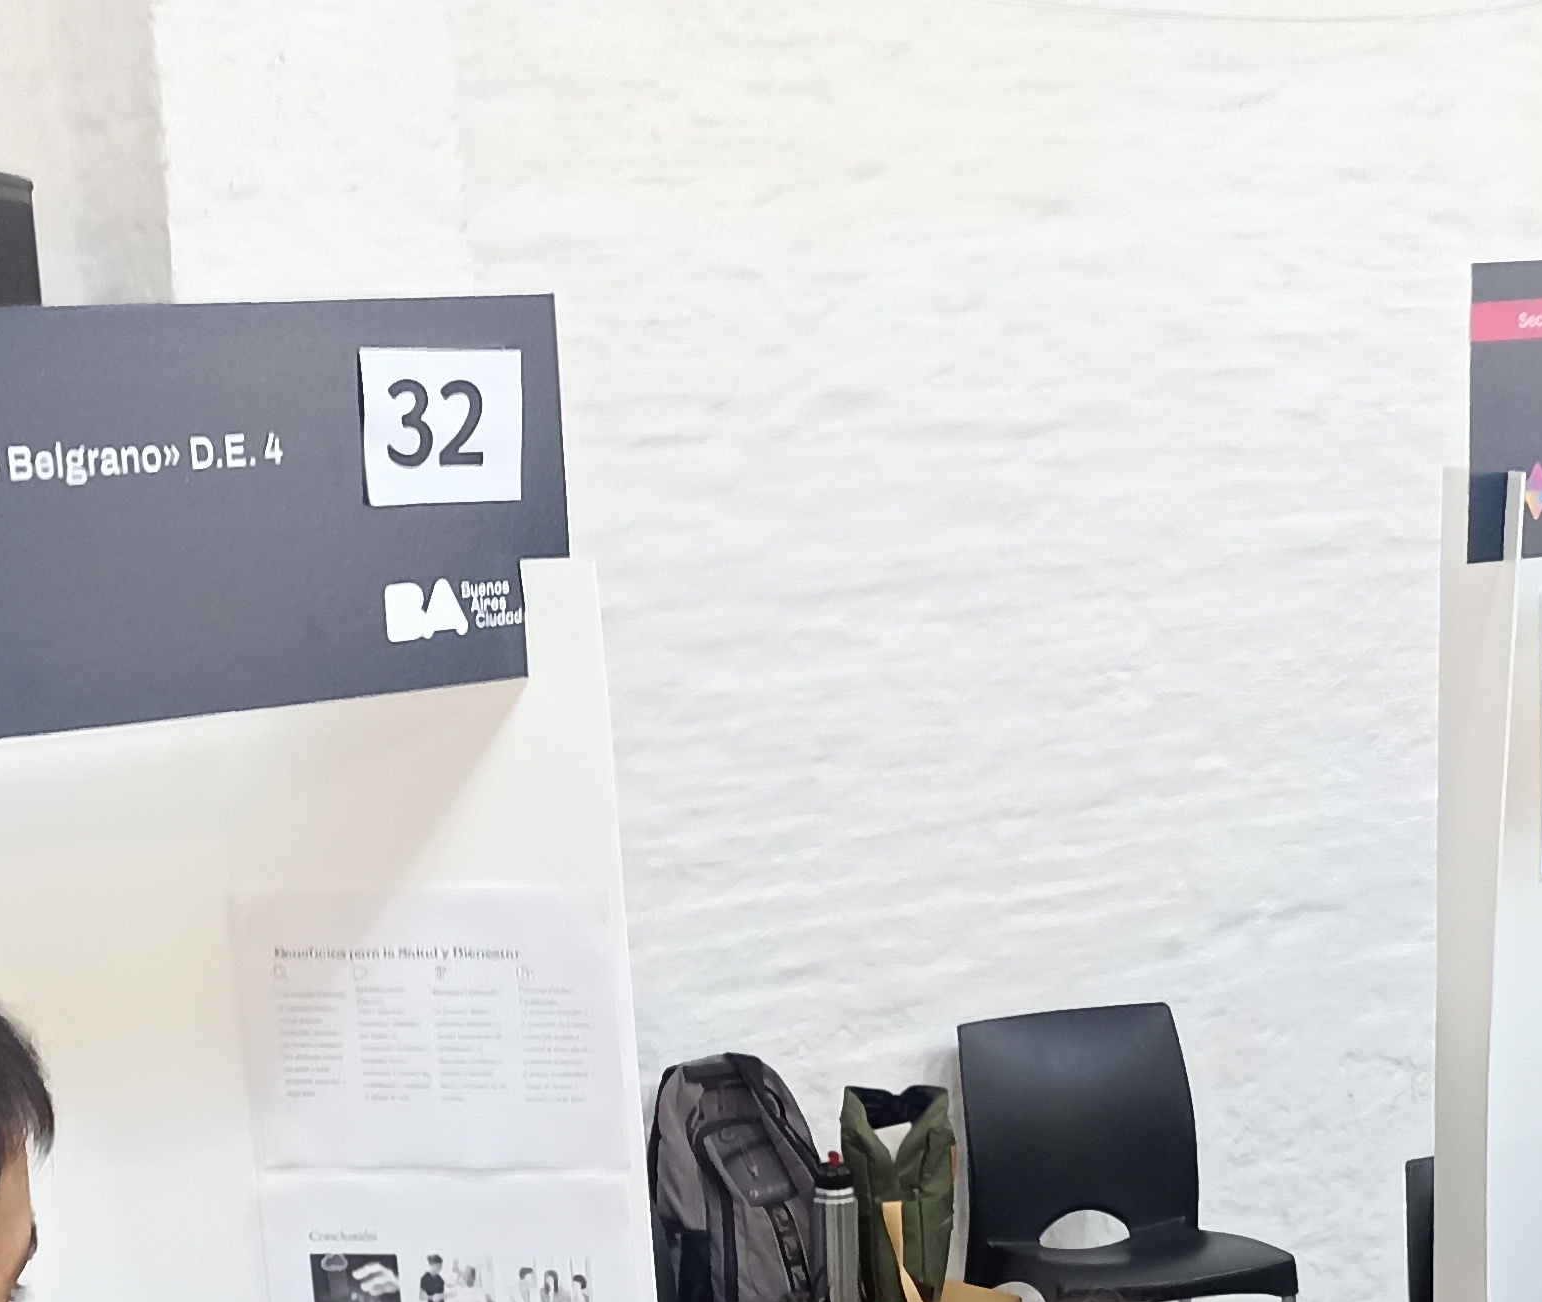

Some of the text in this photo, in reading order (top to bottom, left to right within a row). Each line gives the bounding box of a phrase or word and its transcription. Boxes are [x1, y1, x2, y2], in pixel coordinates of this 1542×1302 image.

[387, 379, 484, 468] 32
[8, 442, 180, 486] Belgrano»
[189, 433, 257, 470] D.E.
[263, 431, 283, 466] 4
[461, 580, 510, 599] Buenos
[471, 596, 507, 612] Aires
[384, 578, 468, 642] BA
[475, 606, 523, 629] Ciudad
